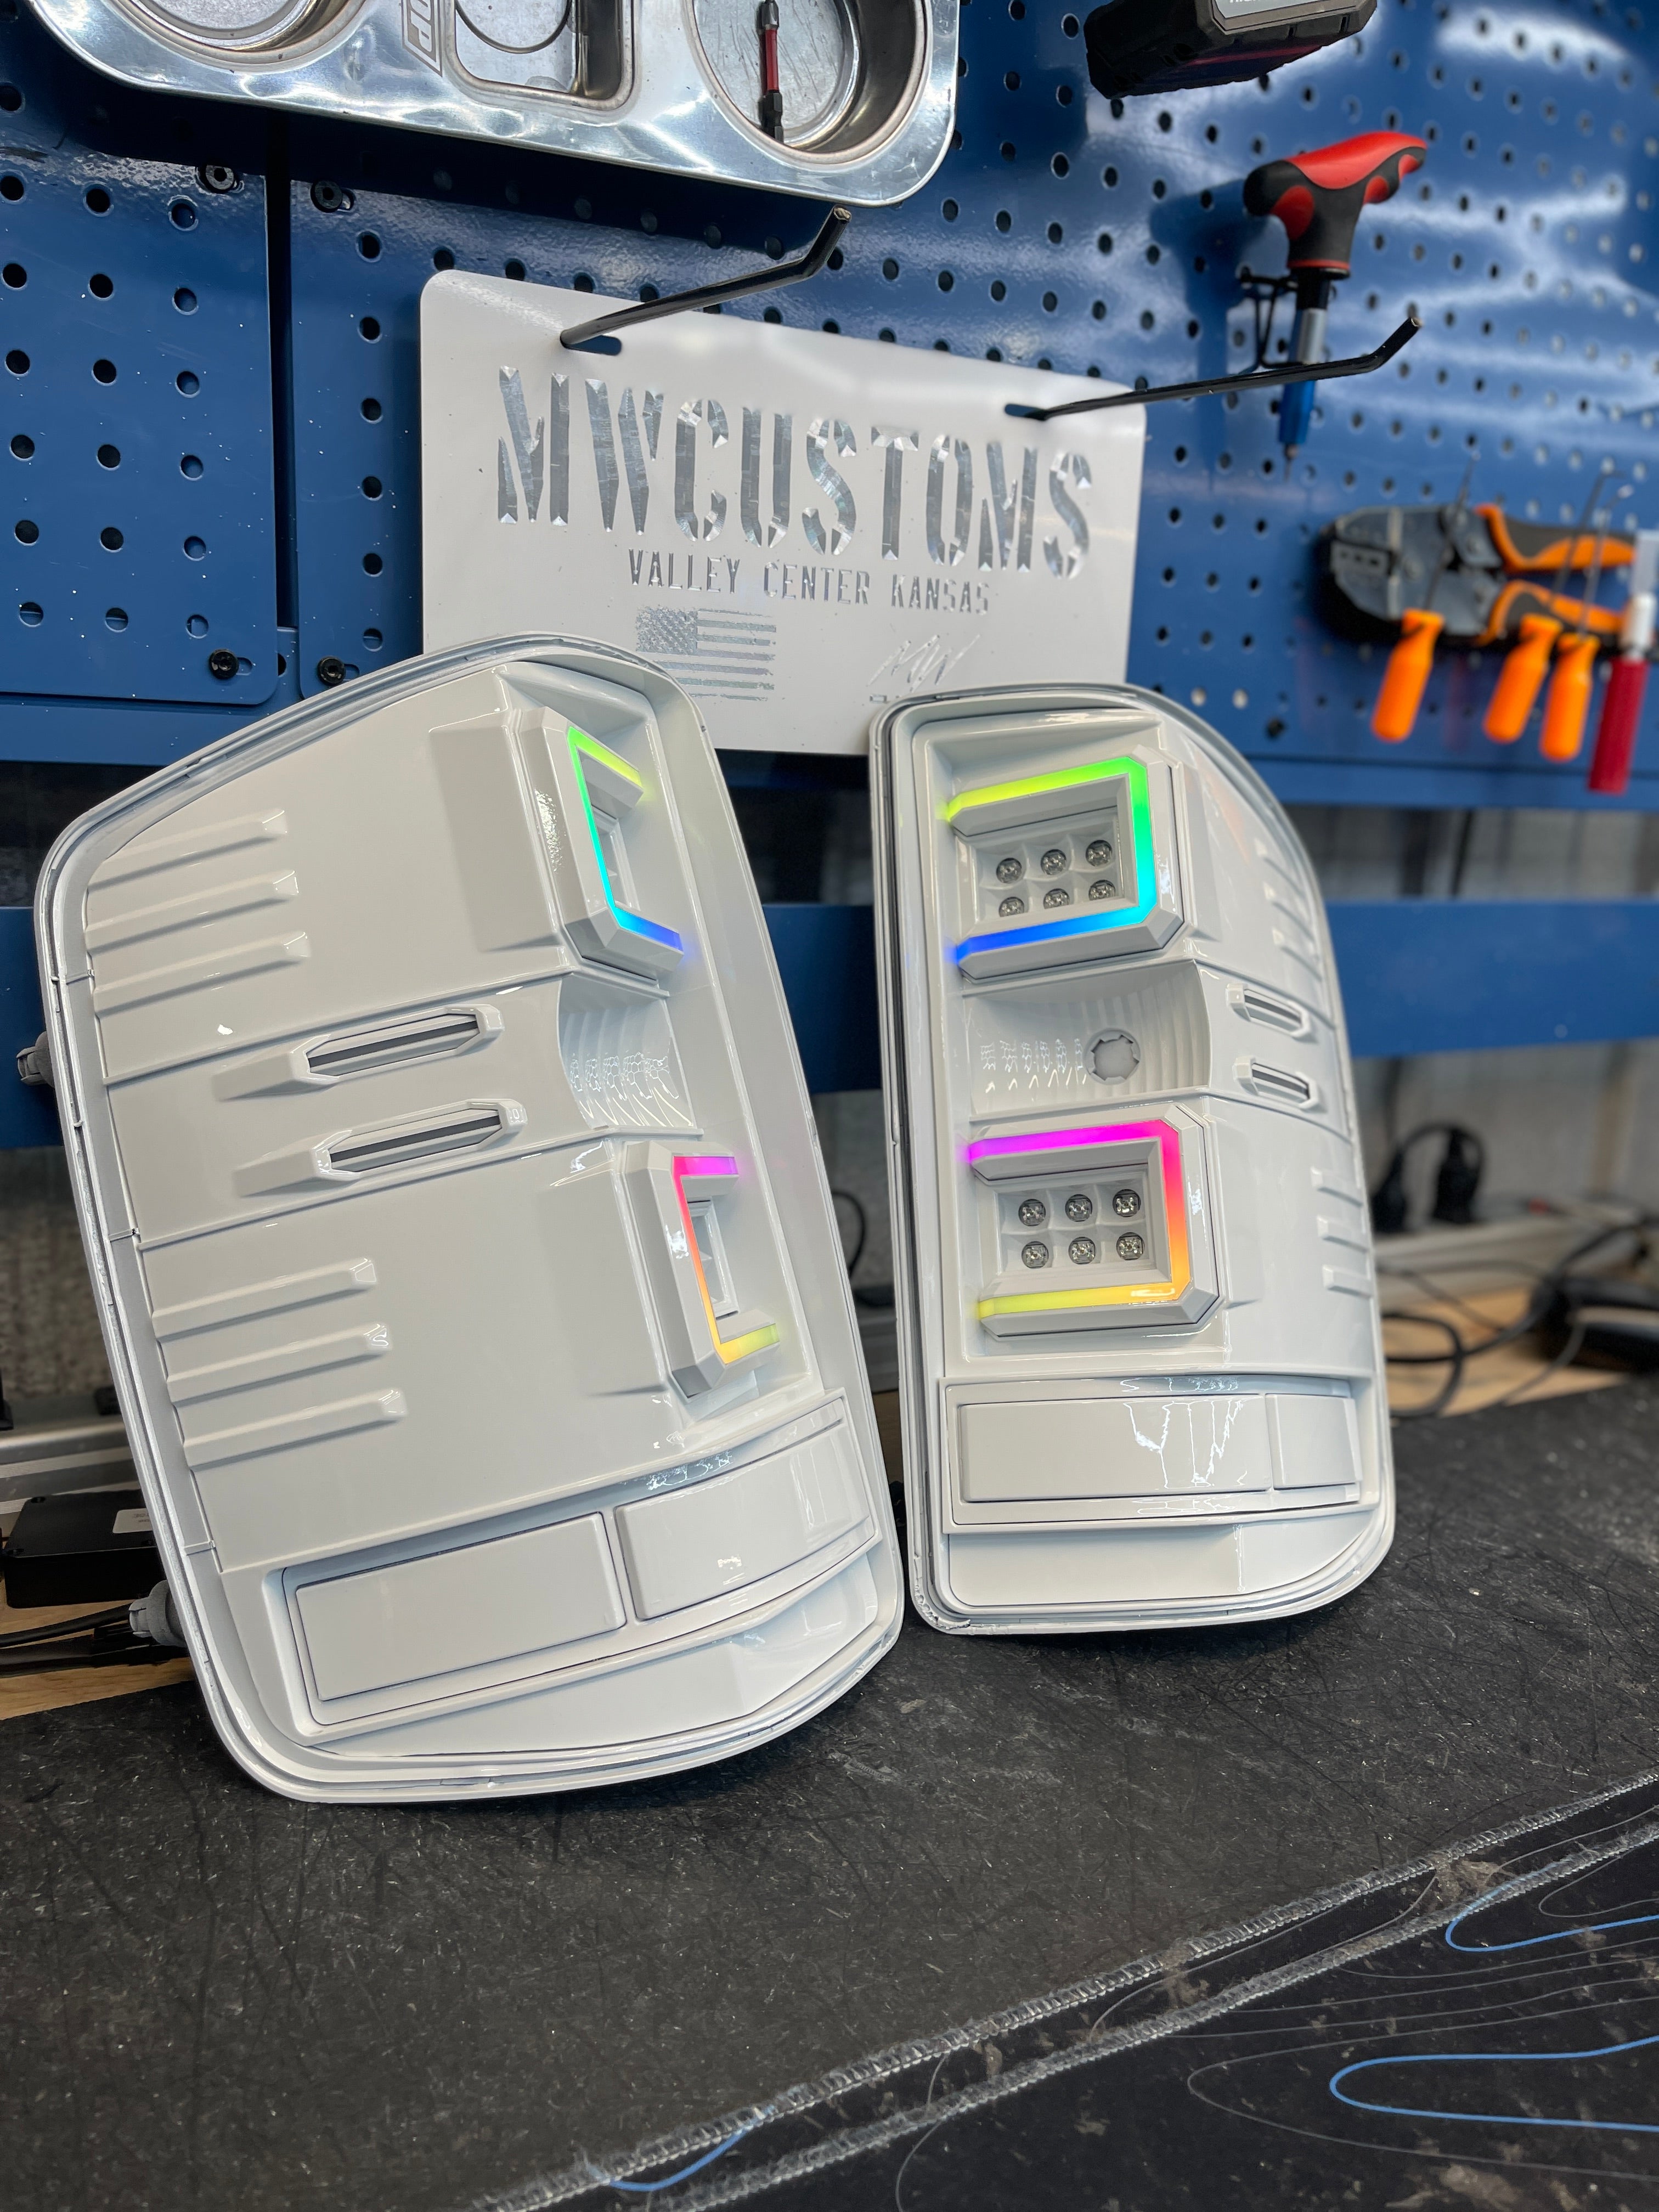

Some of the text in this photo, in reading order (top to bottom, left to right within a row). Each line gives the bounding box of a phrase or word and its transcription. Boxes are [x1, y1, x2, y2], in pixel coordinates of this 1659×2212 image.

[498, 365, 1092, 579] MWCUSTOMS
[629, 548, 990, 616] VALLEY CENTER KANSAS
